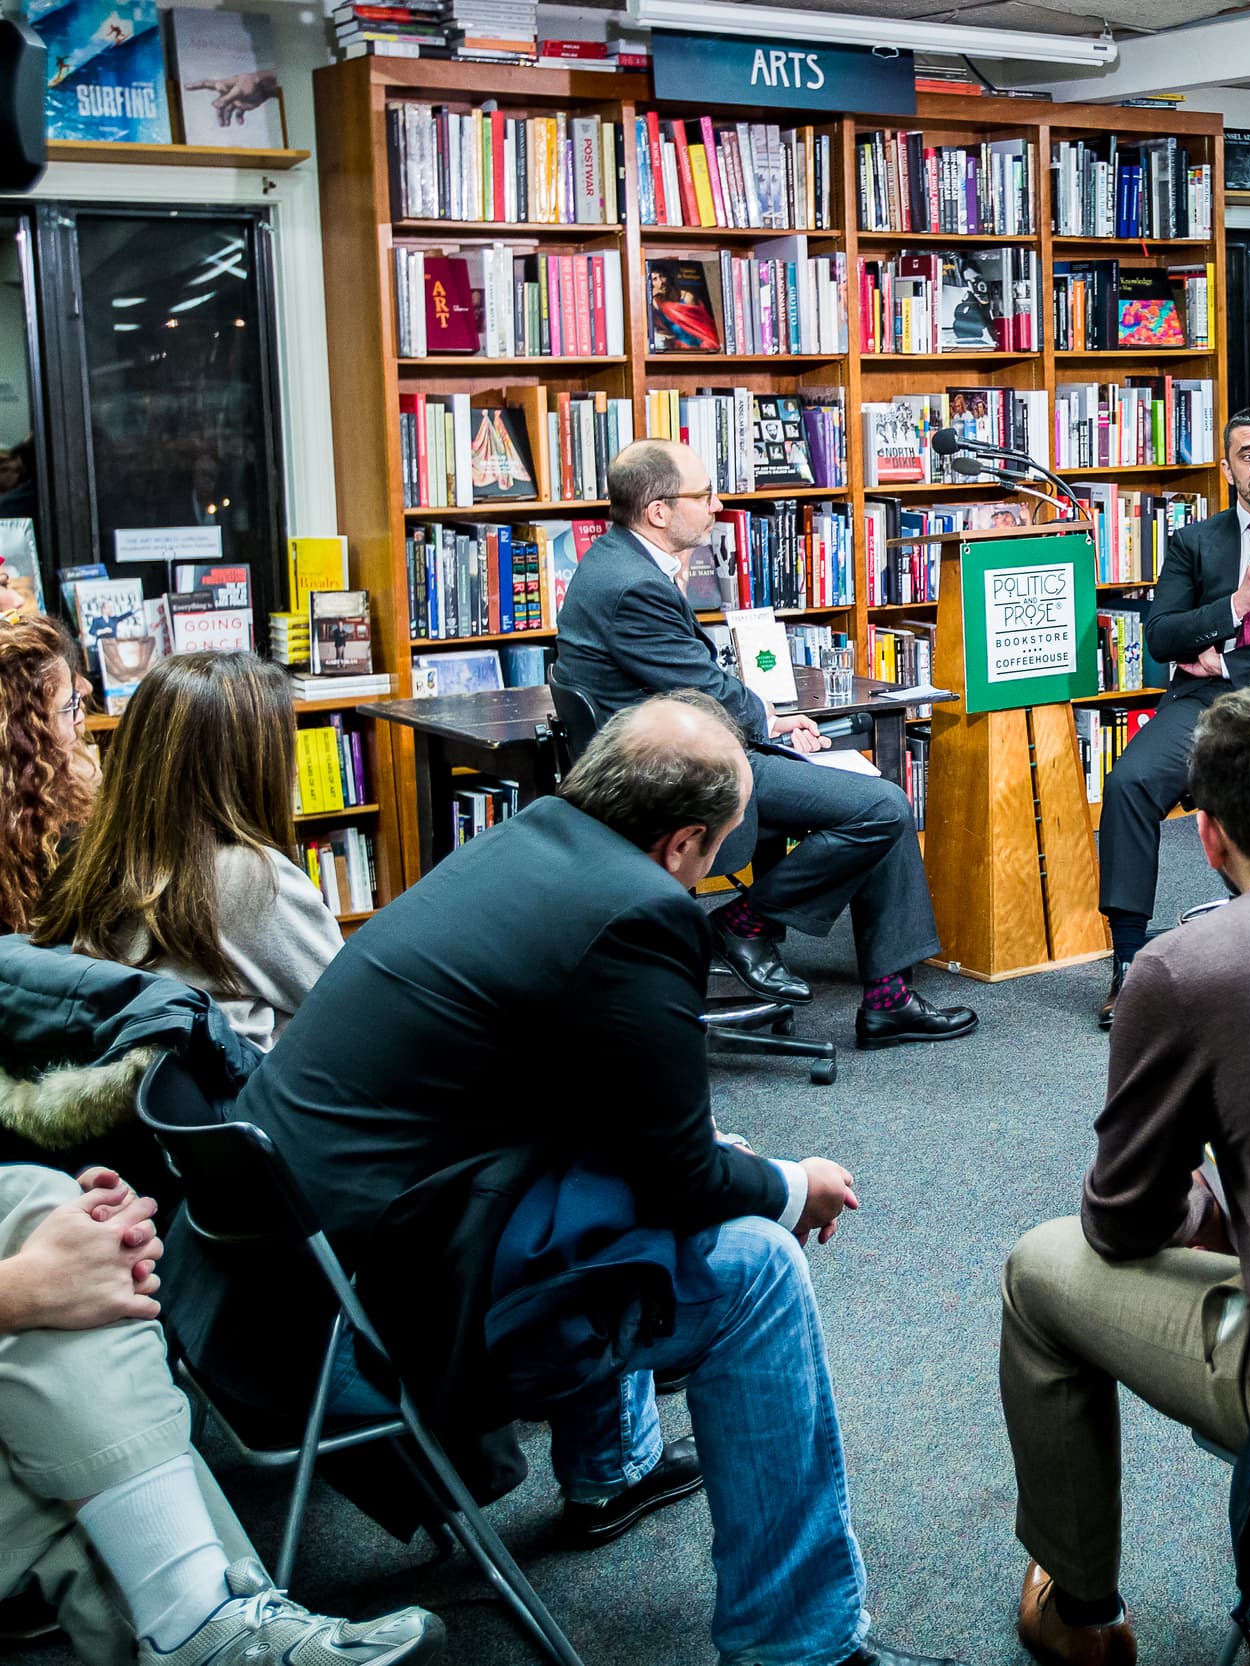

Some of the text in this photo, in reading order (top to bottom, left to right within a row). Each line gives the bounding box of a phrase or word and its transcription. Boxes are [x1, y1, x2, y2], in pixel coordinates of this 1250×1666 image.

[751, 49, 825, 90] ARTS
[76, 84, 156, 118] SURFING
[652, 142, 661, 167] BOSCH
[931, 156, 939, 174] WHO
[583, 138, 595, 197] POSTWAR
[942, 151, 951, 200] UN-AMERICAN
[950, 151, 959, 201] UN-AMERICAN
[431, 280, 450, 330] ART
[789, 286, 798, 326] GIOTTO
[738, 399, 746, 427] ANSELM
[885, 447, 915, 457] NORTH
[892, 457, 916, 469] DIXIE
[579, 525, 603, 534] 1908
[993, 572, 1067, 600] POLITICS
[1023, 596, 1038, 604] AND
[184, 617, 242, 633] GOING
[1004, 602, 1057, 628] PROSE
[185, 637, 242, 653] ONCE
[995, 631, 1070, 649] BOOKSTORE
[995, 651, 1070, 669] COFFEEHOUSE
[306, 757, 314, 777] YEARS
[326, 754, 334, 775] YEARS
[309, 788, 317, 801] ART
